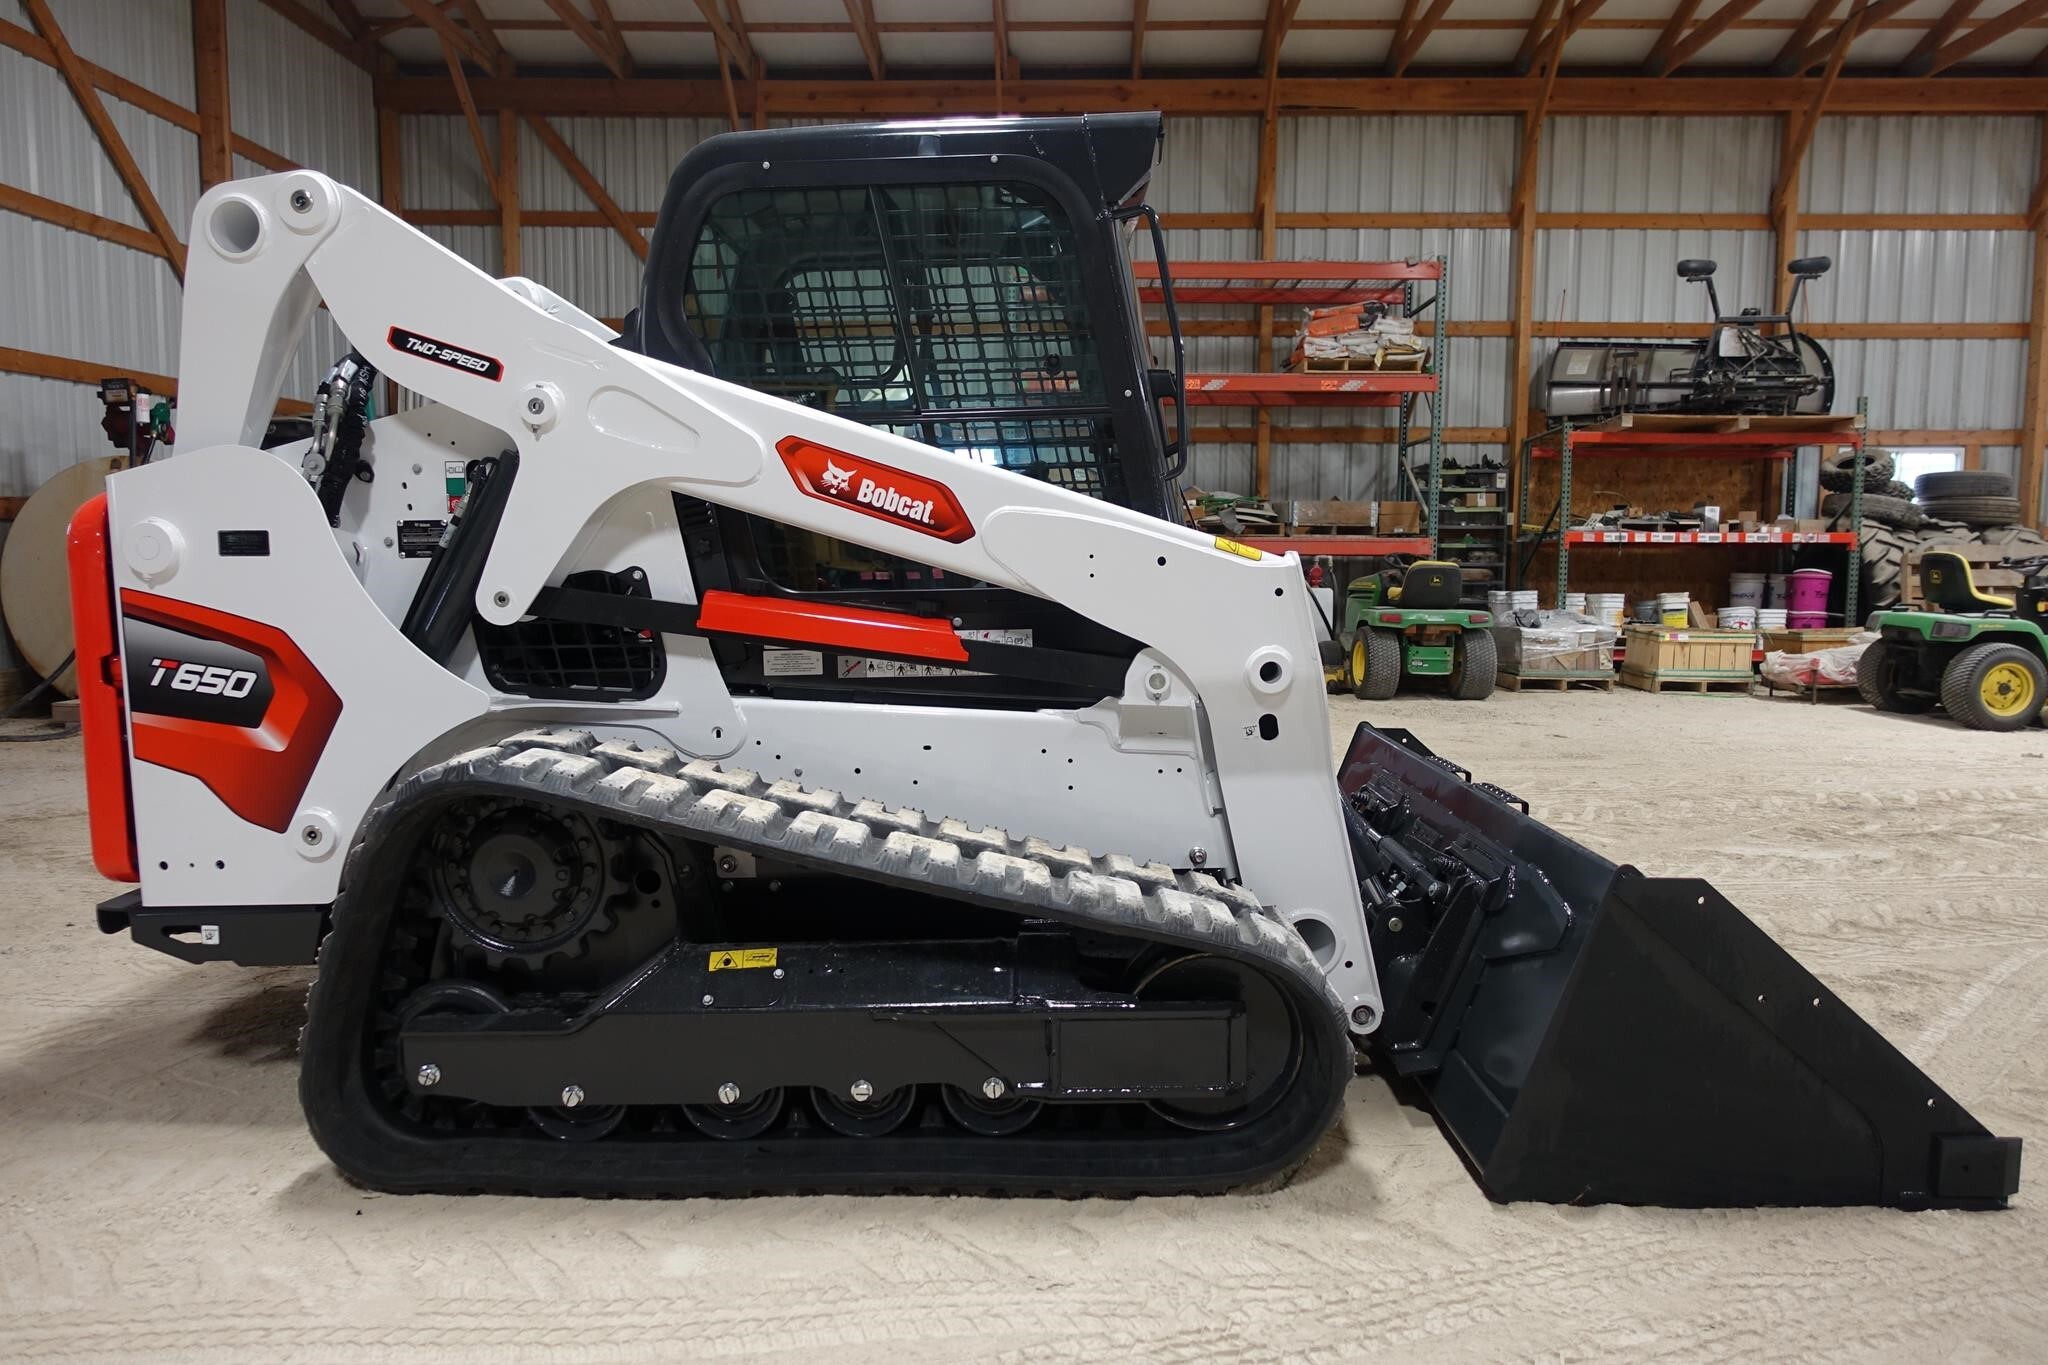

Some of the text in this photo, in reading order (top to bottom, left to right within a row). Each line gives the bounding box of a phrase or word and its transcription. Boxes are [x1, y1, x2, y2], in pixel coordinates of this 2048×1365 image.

[406, 337, 490, 372] TWO-SPEED
[856, 477, 935, 525] Bobcat
[150, 658, 258, 699] T650
